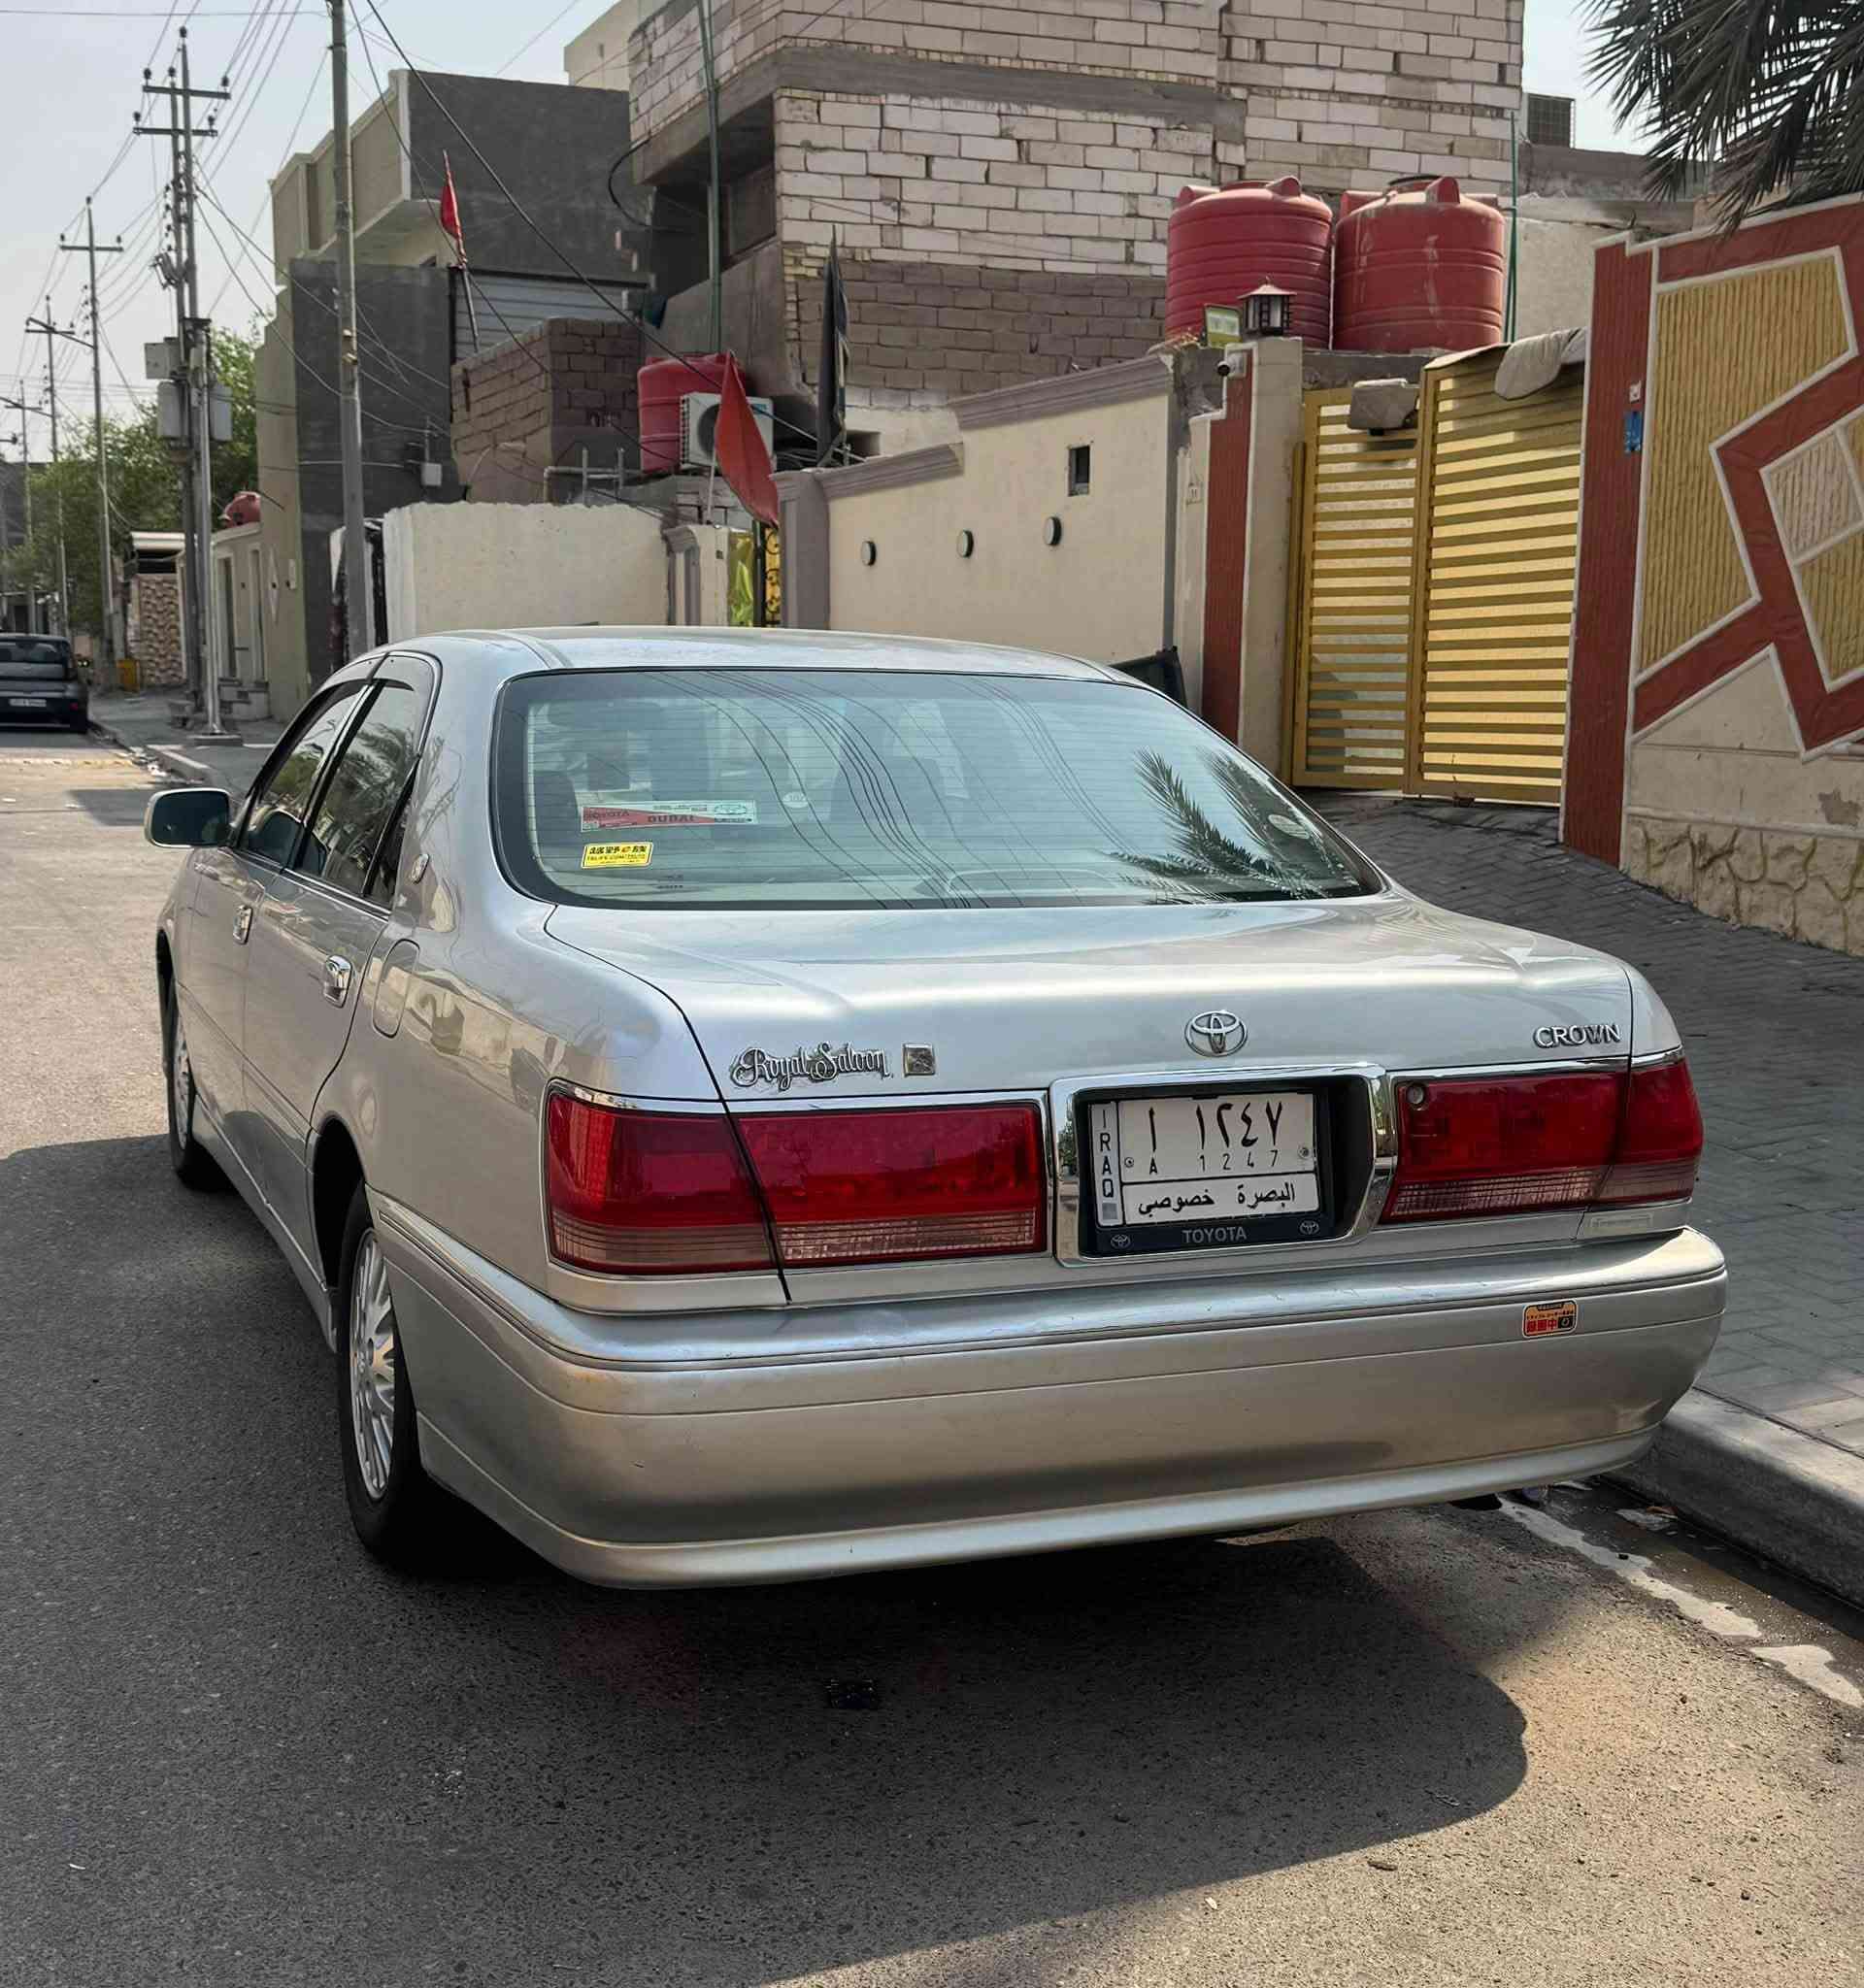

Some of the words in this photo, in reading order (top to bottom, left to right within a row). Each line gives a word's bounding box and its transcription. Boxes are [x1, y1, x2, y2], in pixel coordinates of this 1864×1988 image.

[1534, 1023, 1622, 1048] CROWN
[731, 1047, 811, 1091] Royal
[808, 1042, 893, 1082] Saloon
[1196, 1101, 1282, 1149] ١٢٤٧
[1100, 1110, 1115, 1198] IRAQ
[1149, 1157, 1158, 1175] A
[1138, 1189, 1215, 1217] خصوصي
[1237, 1181, 1296, 1209] البصرة
[1182, 1227, 1247, 1243] TOYOTA
